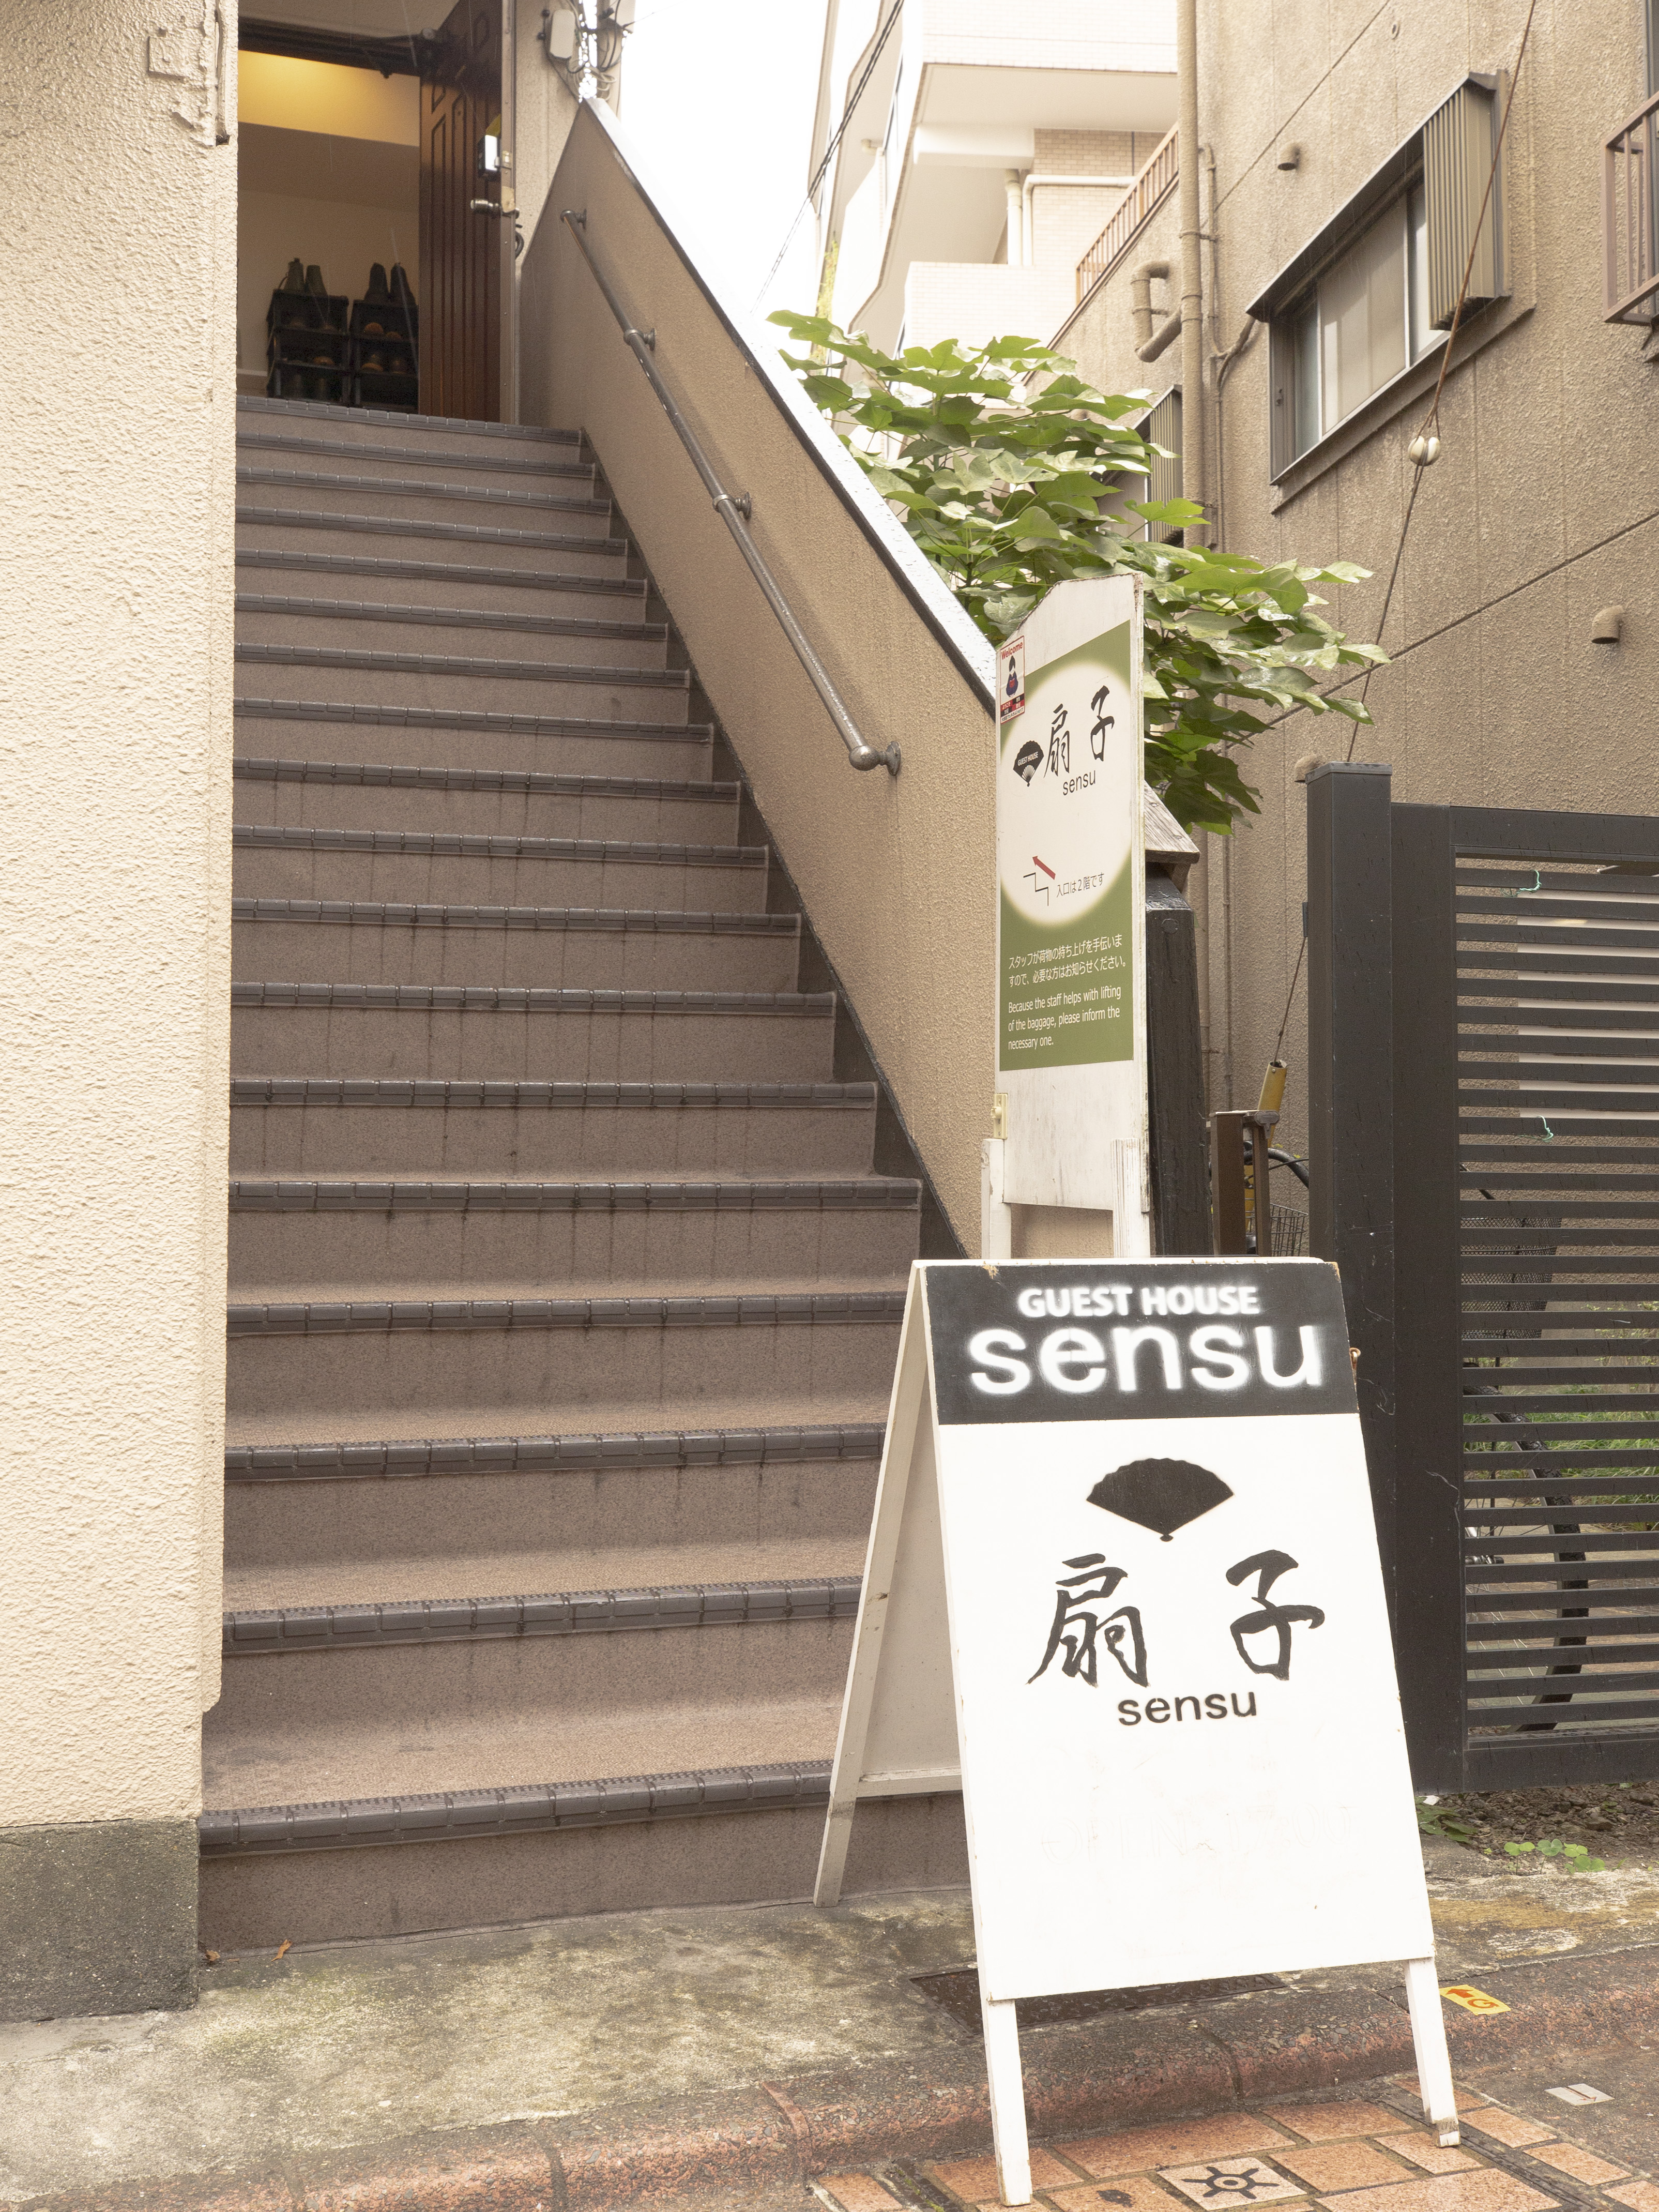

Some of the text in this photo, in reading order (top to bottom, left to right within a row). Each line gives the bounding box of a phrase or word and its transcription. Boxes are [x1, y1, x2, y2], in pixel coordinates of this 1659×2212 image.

[1001, 642, 1023, 660] Welcome
[1043, 686, 1115, 778] 扇子
[1017, 751, 1039, 766] GUEST HOUSE
[1063, 770, 1095, 795] sensu
[1009, 934, 1122, 969] スタッフが荷物の持ち上げを手伝いま
[1009, 956, 1126, 987] すので、必要な方はお知らせください。
[1009, 986, 1121, 1013] Because the staff helps with lifting
[1008, 1005, 1120, 1032] of the baggage, please inform the
[1008, 1036, 1054, 1050] necessary one.
[1016, 1285, 1260, 1318] GUEST HOUSE
[969, 1325, 1323, 1395] sensu
[1026, 1549, 1325, 1688] 扇子
[1118, 1690, 1257, 1727] sensu
